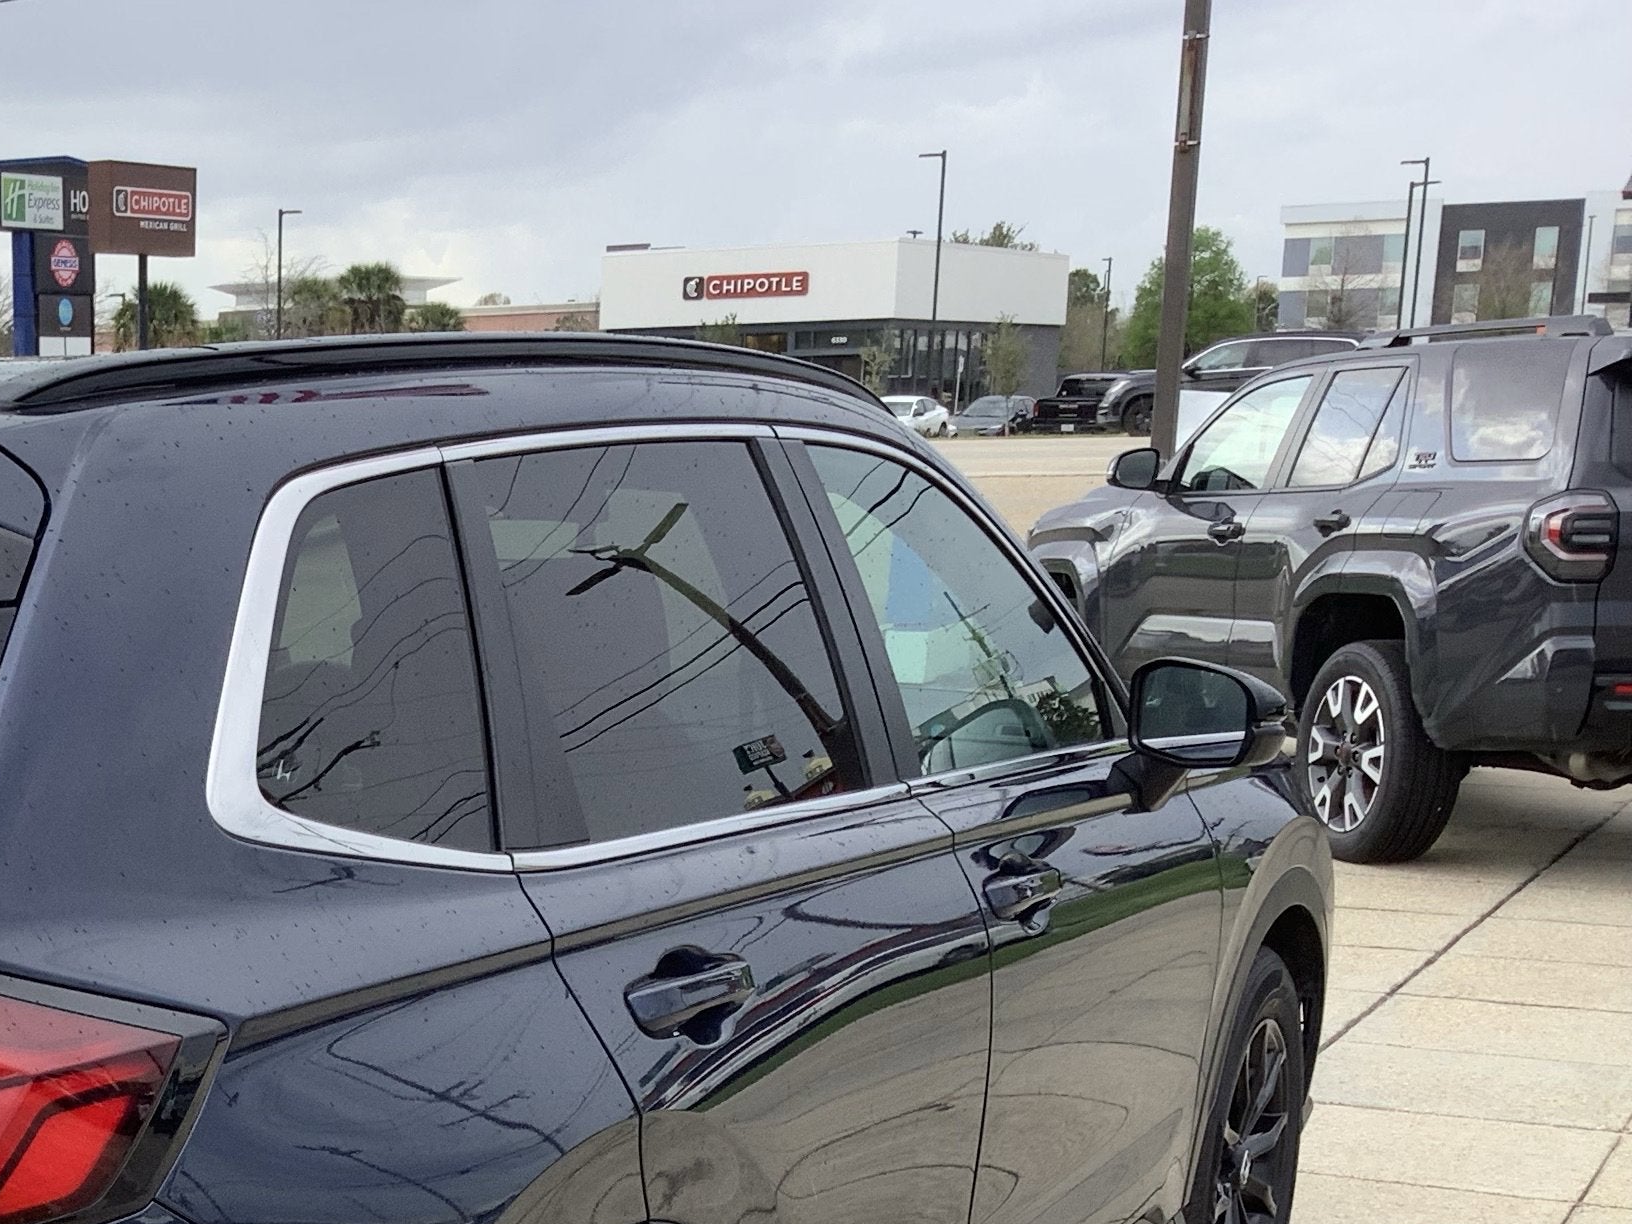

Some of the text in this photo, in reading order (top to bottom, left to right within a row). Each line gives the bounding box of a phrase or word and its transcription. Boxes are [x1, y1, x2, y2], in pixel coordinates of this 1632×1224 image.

[28, 193, 60, 212] Express
[131, 194, 188, 213] CHIPOTLE
[139, 220, 187, 231] MEXICAN GRILL
[708, 276, 803, 295] CHIPOTLE
